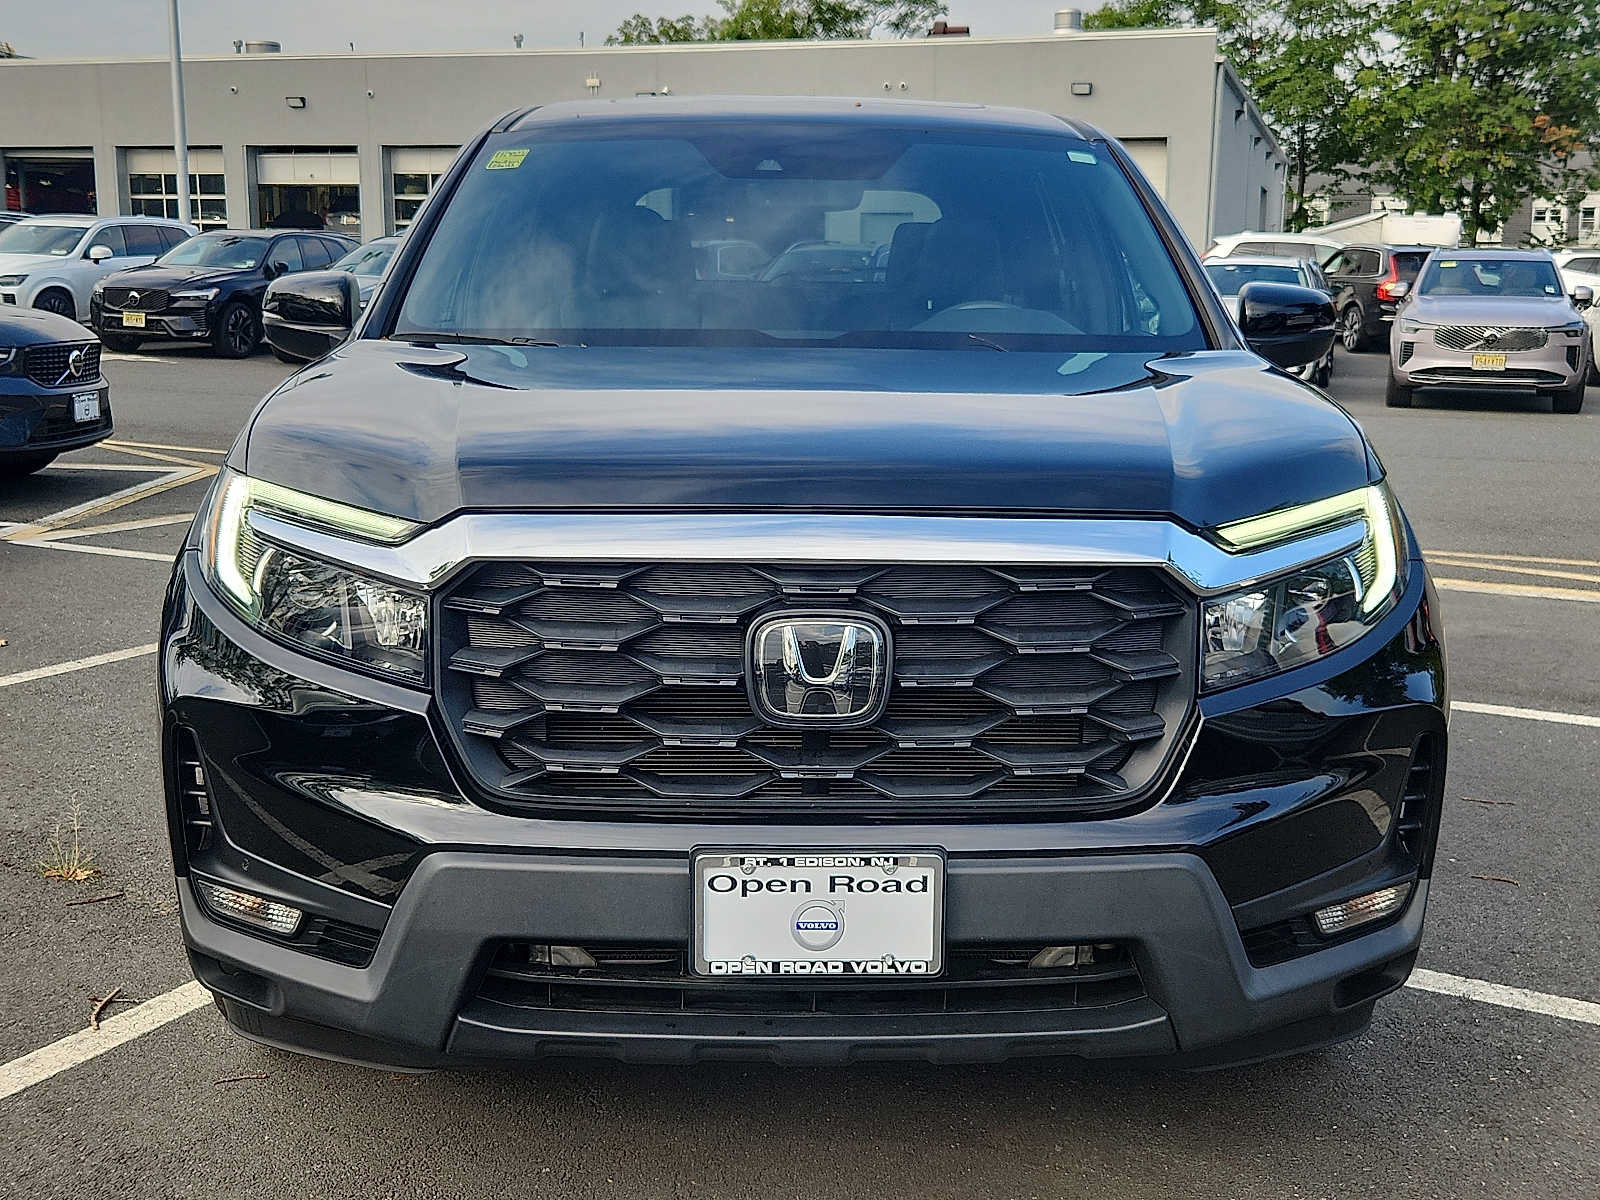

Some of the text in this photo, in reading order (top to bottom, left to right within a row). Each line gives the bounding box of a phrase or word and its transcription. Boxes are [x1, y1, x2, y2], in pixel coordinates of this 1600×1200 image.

[780, 857, 788, 867] 1
[707, 874, 928, 898] Open Road
[710, 961, 927, 974] OPEN ROAD VOLVO
